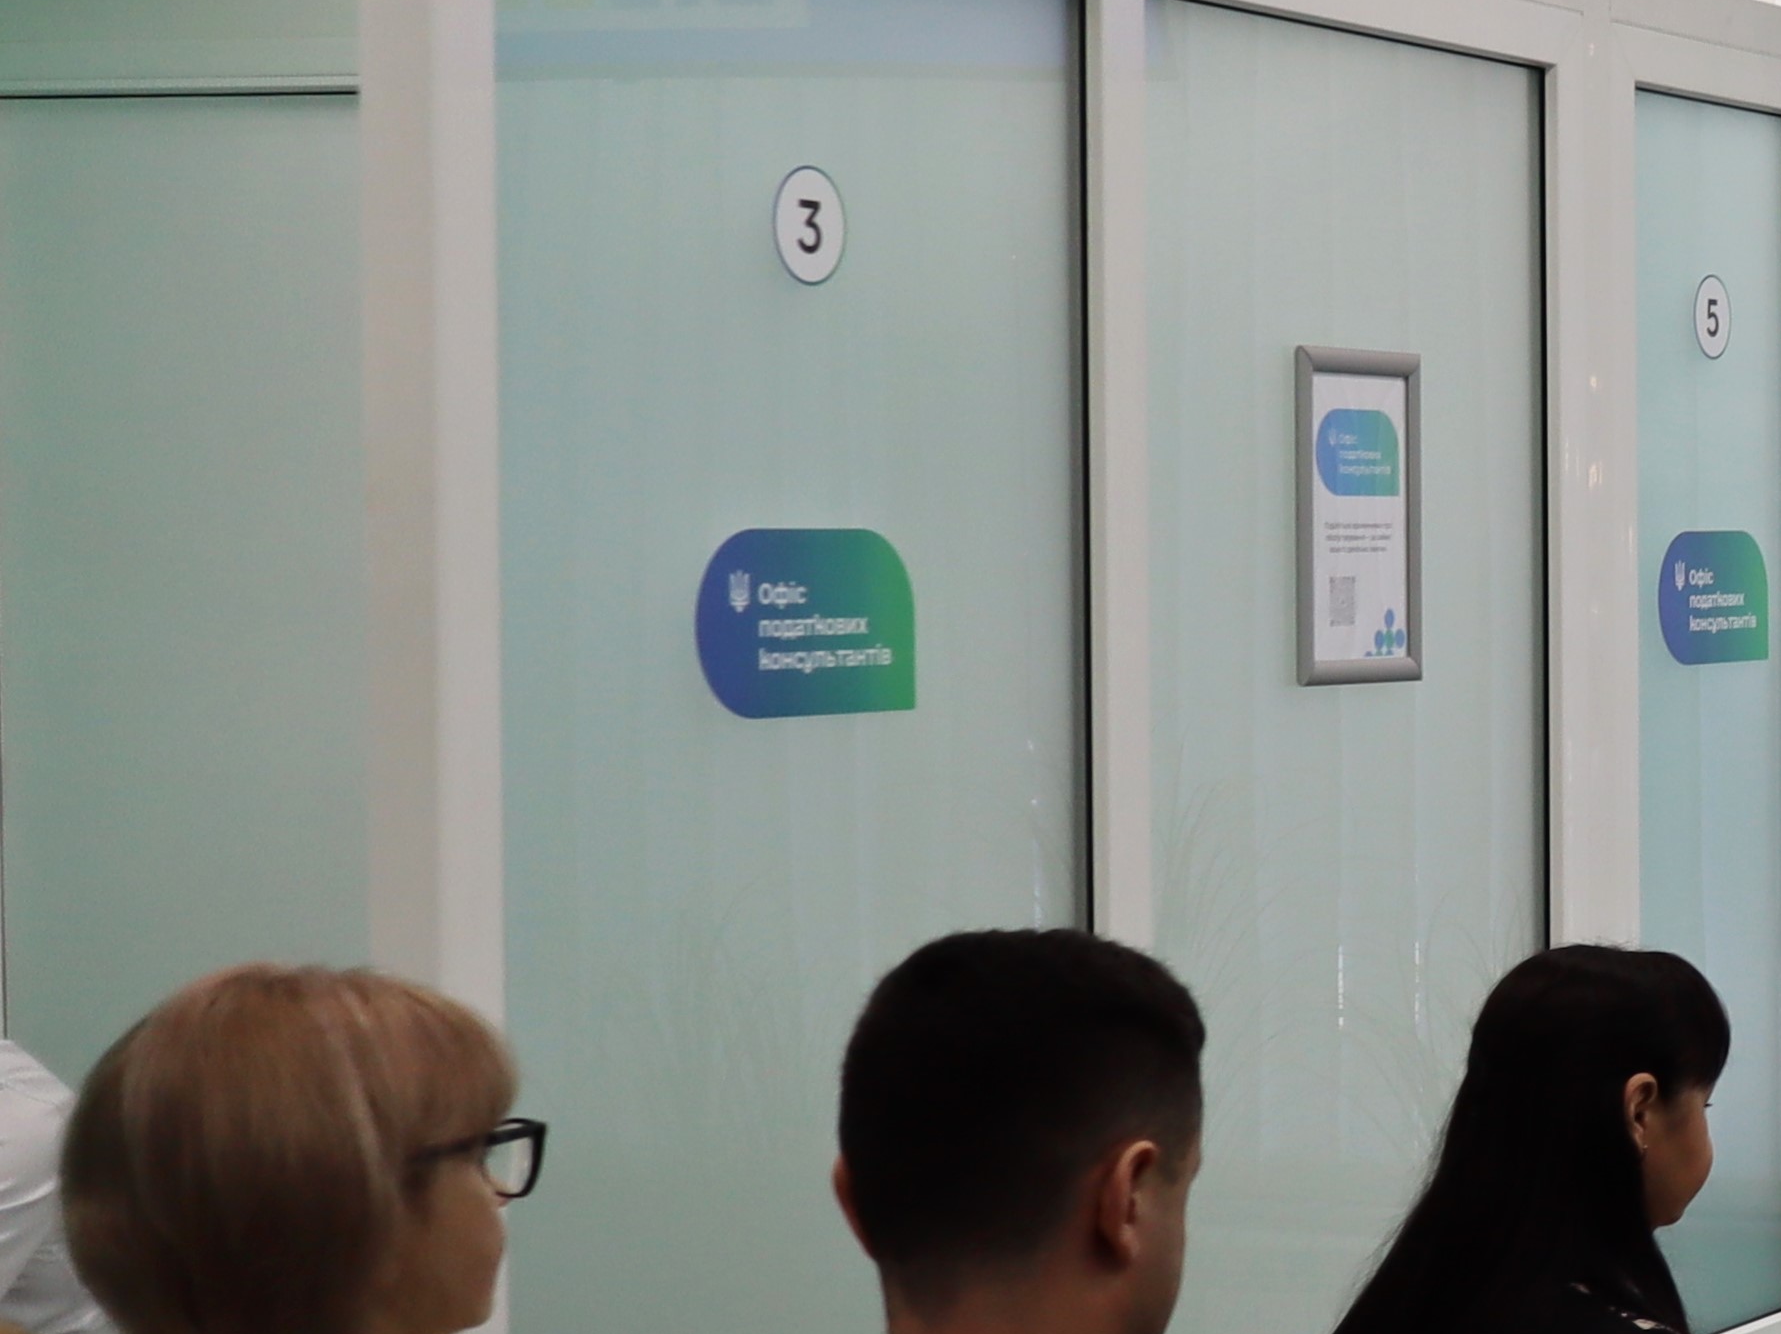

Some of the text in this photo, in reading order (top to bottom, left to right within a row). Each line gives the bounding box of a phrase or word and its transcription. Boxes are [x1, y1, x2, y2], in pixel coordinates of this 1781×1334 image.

[796, 198, 823, 255] 3
[1705, 298, 1720, 338] 5
[1688, 568, 1714, 589] Офіс
[757, 581, 807, 610] Офіс
[757, 614, 869, 640] податкових
[757, 643, 893, 674] консультантів
